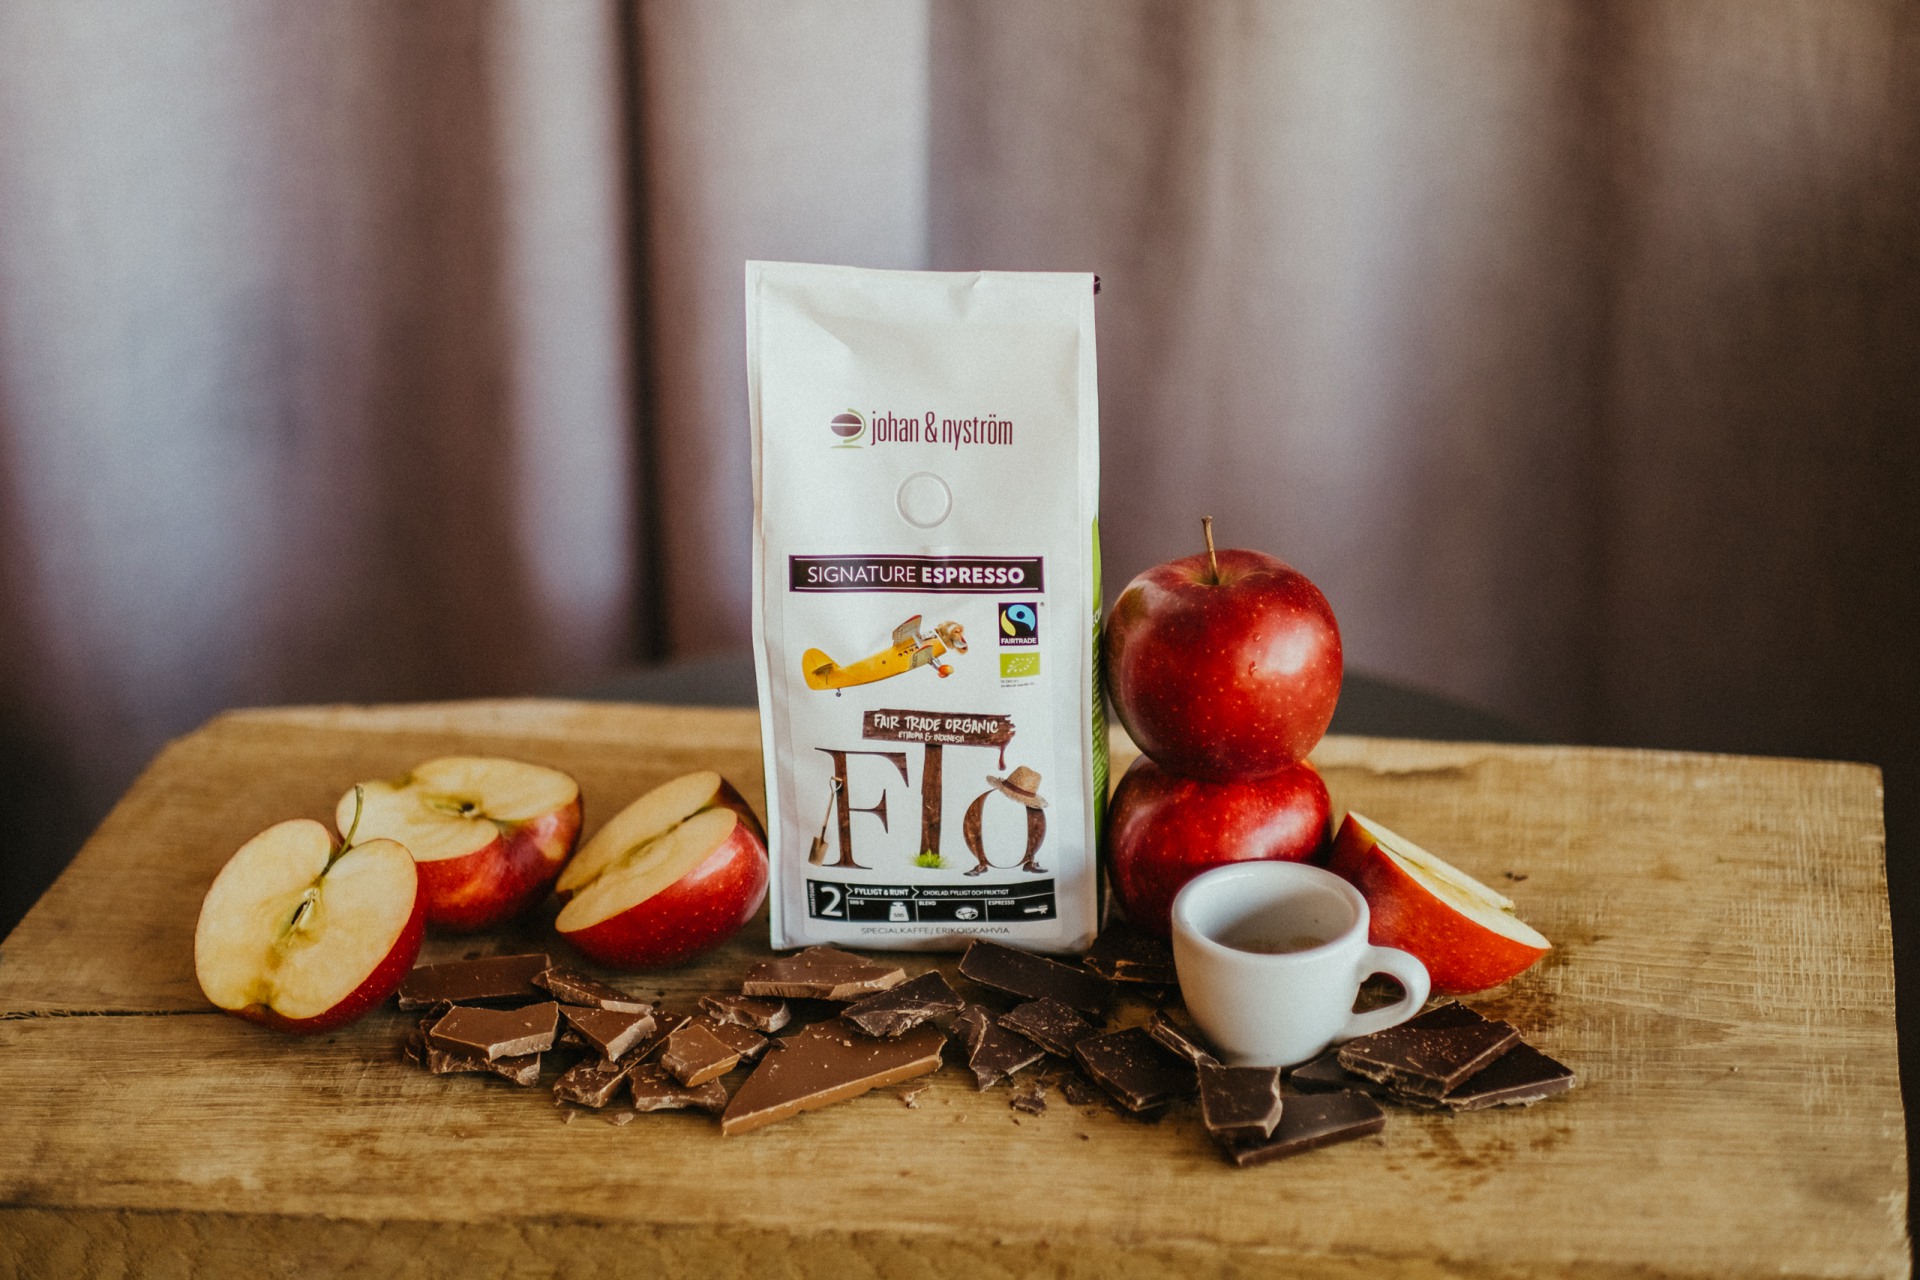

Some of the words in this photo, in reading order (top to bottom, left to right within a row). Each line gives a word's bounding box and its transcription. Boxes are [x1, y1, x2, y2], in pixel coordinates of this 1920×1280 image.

[870, 410, 919, 446] johan
[924, 411, 938, 443] &
[942, 413, 1013, 451] nyström
[807, 565, 917, 583] SIGNATURE
[921, 567, 1025, 584] ESPRESSO
[1001, 637, 1037, 645] FAIRTRADE
[874, 713, 900, 730] FAIR
[905, 715, 941, 732] TRADE
[945, 718, 999, 734] ORGANIC
[925, 732, 933, 741] &
[854, 887, 882, 896] FYLLIGT
[883, 888, 889, 896] &
[889, 888, 909, 896] RUNT
[820, 886, 843, 917] 2
[936, 927, 1010, 935] ERIKOISKAHVIA
